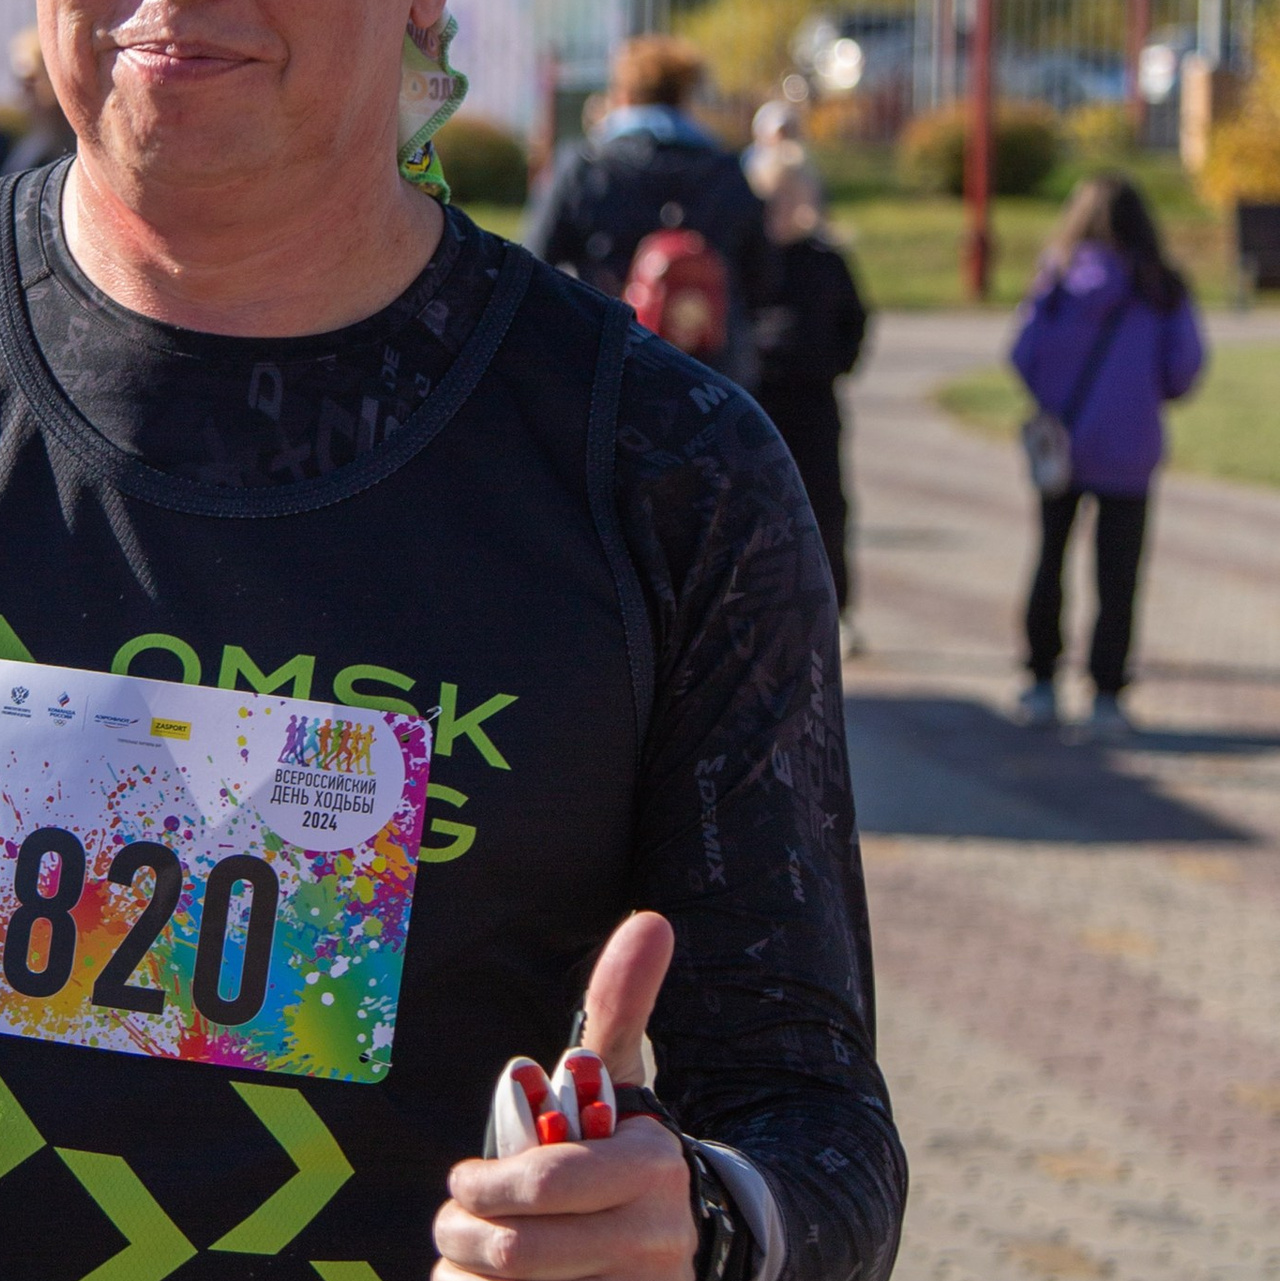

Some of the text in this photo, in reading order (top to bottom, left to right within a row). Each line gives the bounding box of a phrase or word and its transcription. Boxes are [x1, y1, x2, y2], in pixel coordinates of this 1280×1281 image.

[155, 722, 188, 733] ZASPORT
[274, 768, 377, 796] ВСЕРОССИЙСКИЙ
[270, 784, 375, 815] ДЕНЬ ХОДЬБЫ
[302, 809, 338, 832] 2024
[2, 826, 280, 1027] 820
